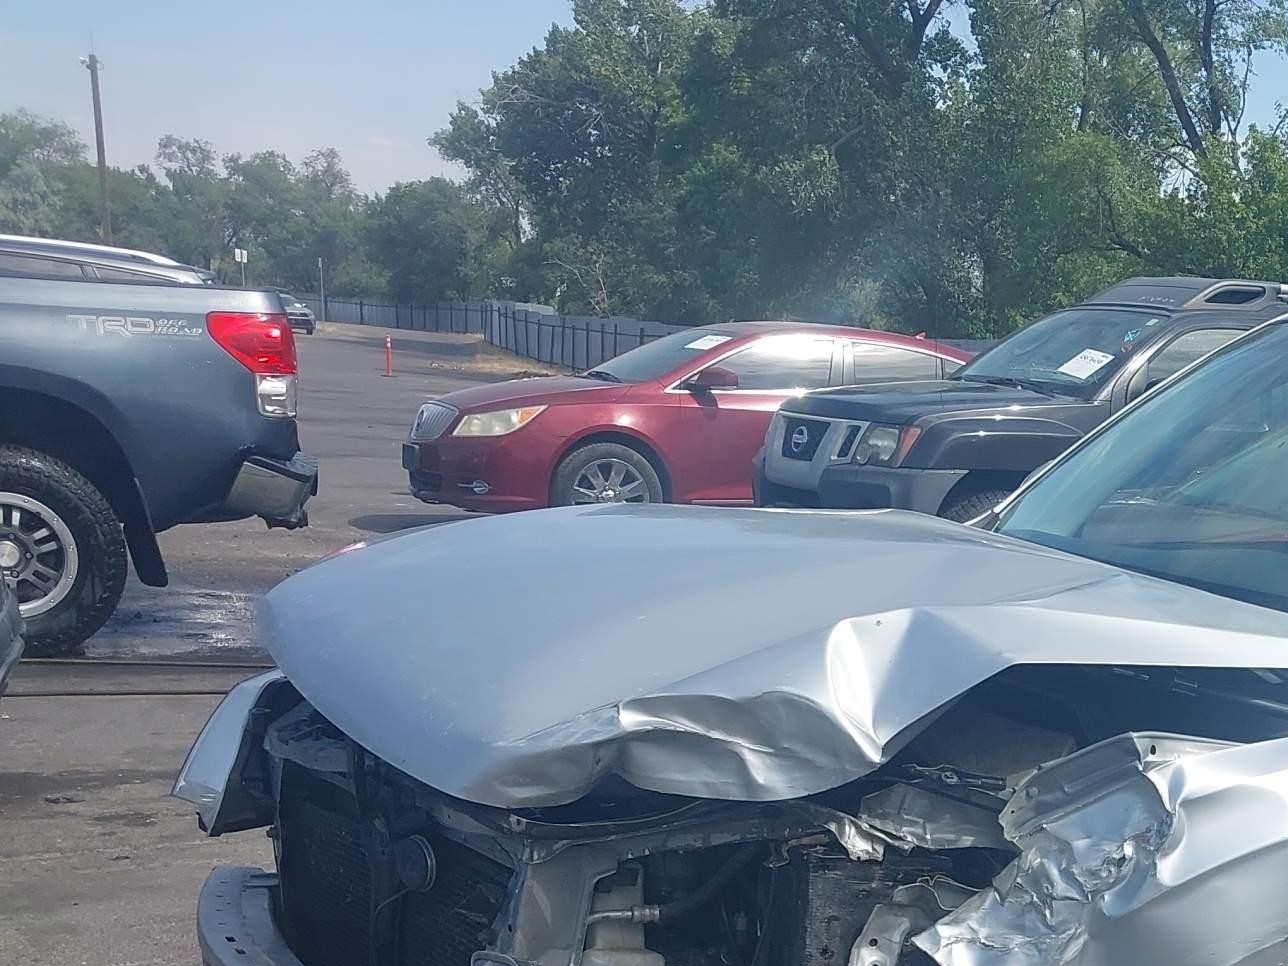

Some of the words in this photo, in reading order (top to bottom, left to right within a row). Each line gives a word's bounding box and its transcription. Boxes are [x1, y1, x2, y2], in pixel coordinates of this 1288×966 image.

[66, 314, 155, 337] TRD
[155, 318, 188, 328] OFF
[154, 326, 203, 336] ROAD
